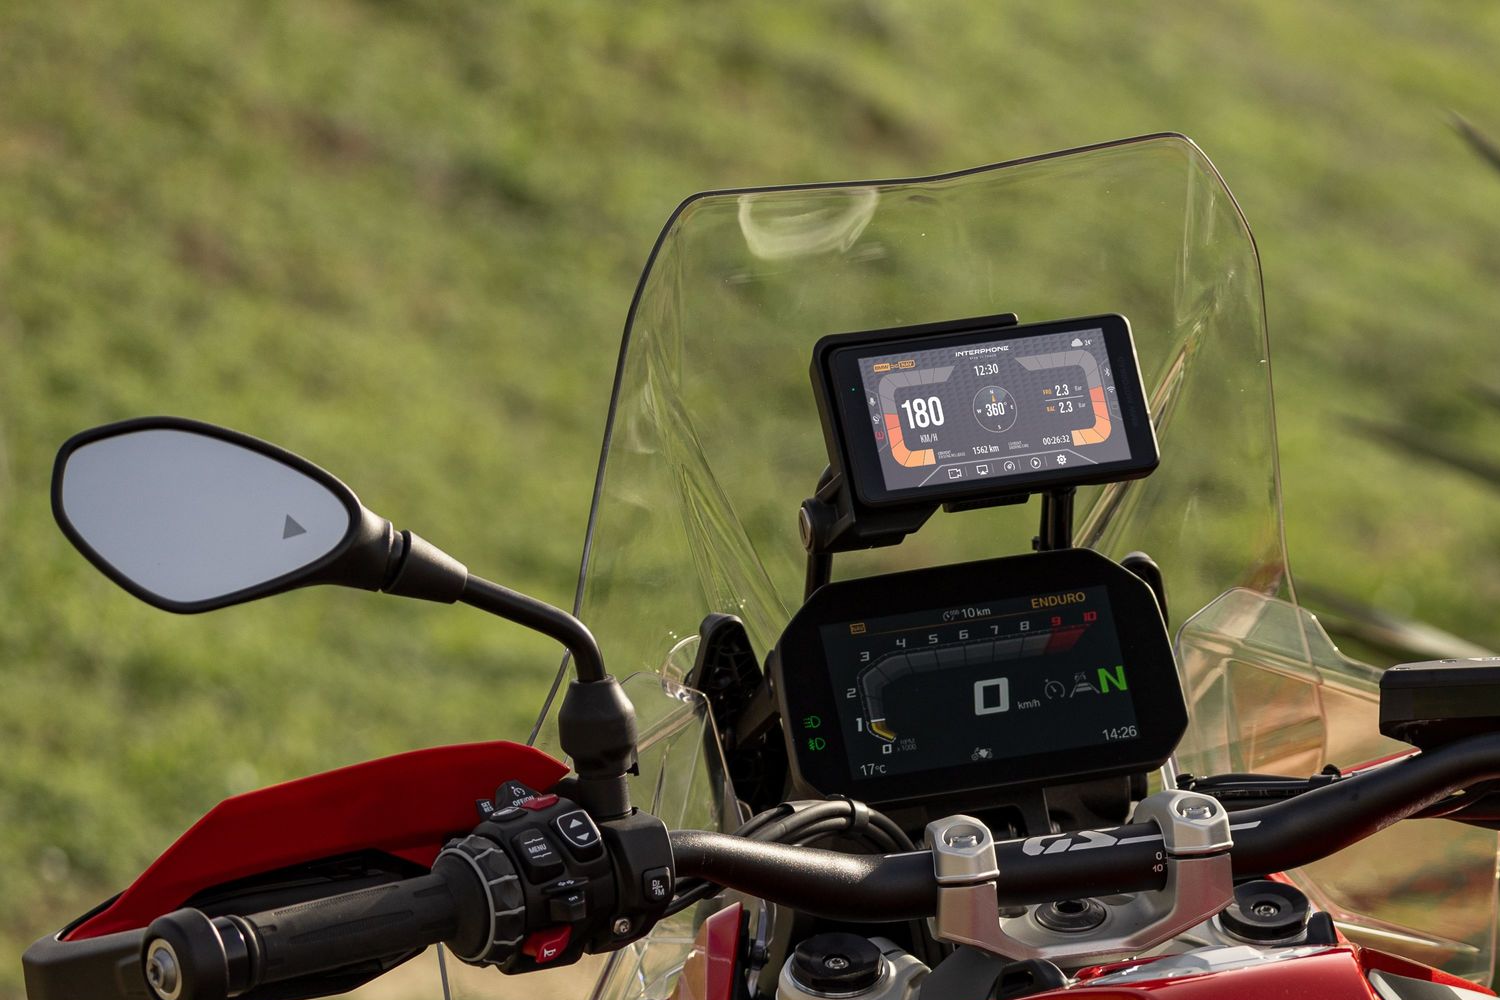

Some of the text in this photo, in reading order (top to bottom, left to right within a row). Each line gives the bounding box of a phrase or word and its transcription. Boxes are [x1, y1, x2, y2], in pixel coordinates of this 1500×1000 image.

[955, 345, 1009, 357] INTERPHONE
[974, 363, 998, 377] 12:30
[1055, 384, 1069, 397] 2.3
[901, 396, 944, 429] 180
[985, 402, 1007, 417] 360°
[1059, 401, 1073, 414] 2.3
[920, 433, 938, 443] KM/H
[1042, 434, 1071, 446] 00:26:32
[972, 446, 988, 455] 1562
[989, 445, 1000, 453] km
[1031, 592, 1086, 609] ENDURO
[961, 607, 992, 619] 10 km
[1083, 611, 1097, 622] 10
[1020, 621, 1030, 631] 8
[1051, 616, 1062, 626] 9
[959, 630, 968, 640] 6
[990, 625, 999, 635] 7
[896, 638, 906, 648] 4
[928, 634, 938, 644] 5
[860, 651, 870, 662] 3
[1097, 665, 1128, 693] N
[846, 688, 857, 699] 2
[974, 677, 1041, 716] 0 km/h
[856, 718, 862, 732] 1
[1102, 725, 1138, 740] 14:26
[882, 744, 892, 754] 0
[860, 763, 887, 776] 17°C
[1022, 827, 1118, 856] GS
[528, 844, 546, 854] MENU
[1155, 851, 1163, 861] 0
[1152, 863, 1163, 872] 10
